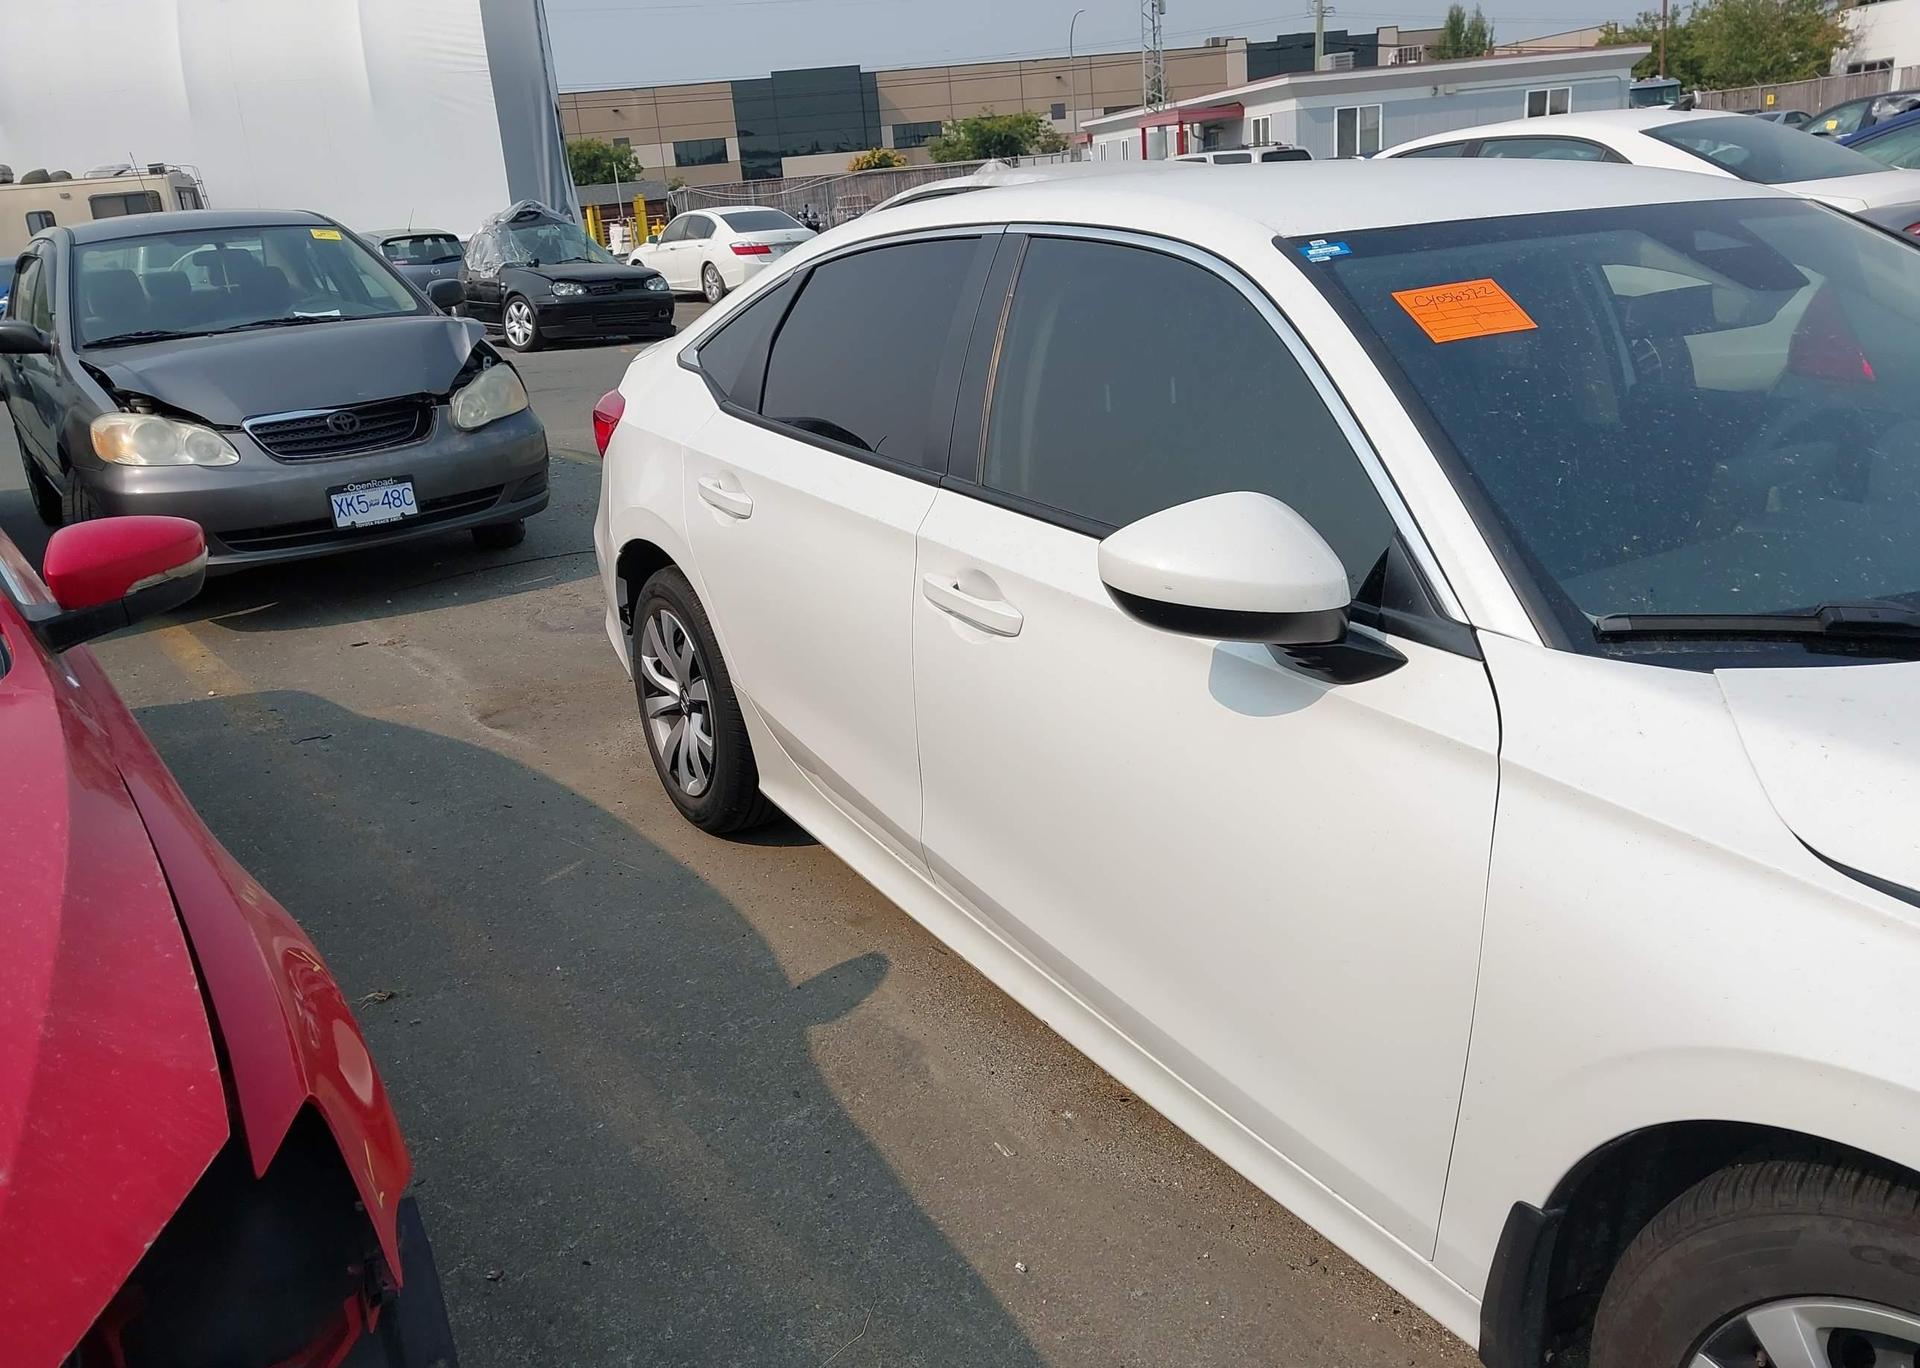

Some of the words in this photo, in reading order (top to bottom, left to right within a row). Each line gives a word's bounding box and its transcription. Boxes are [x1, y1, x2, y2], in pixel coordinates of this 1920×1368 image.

[347, 477, 394, 492] OpenRoad
[333, 494, 370, 518] XK5
[380, 487, 414, 510] 48C
